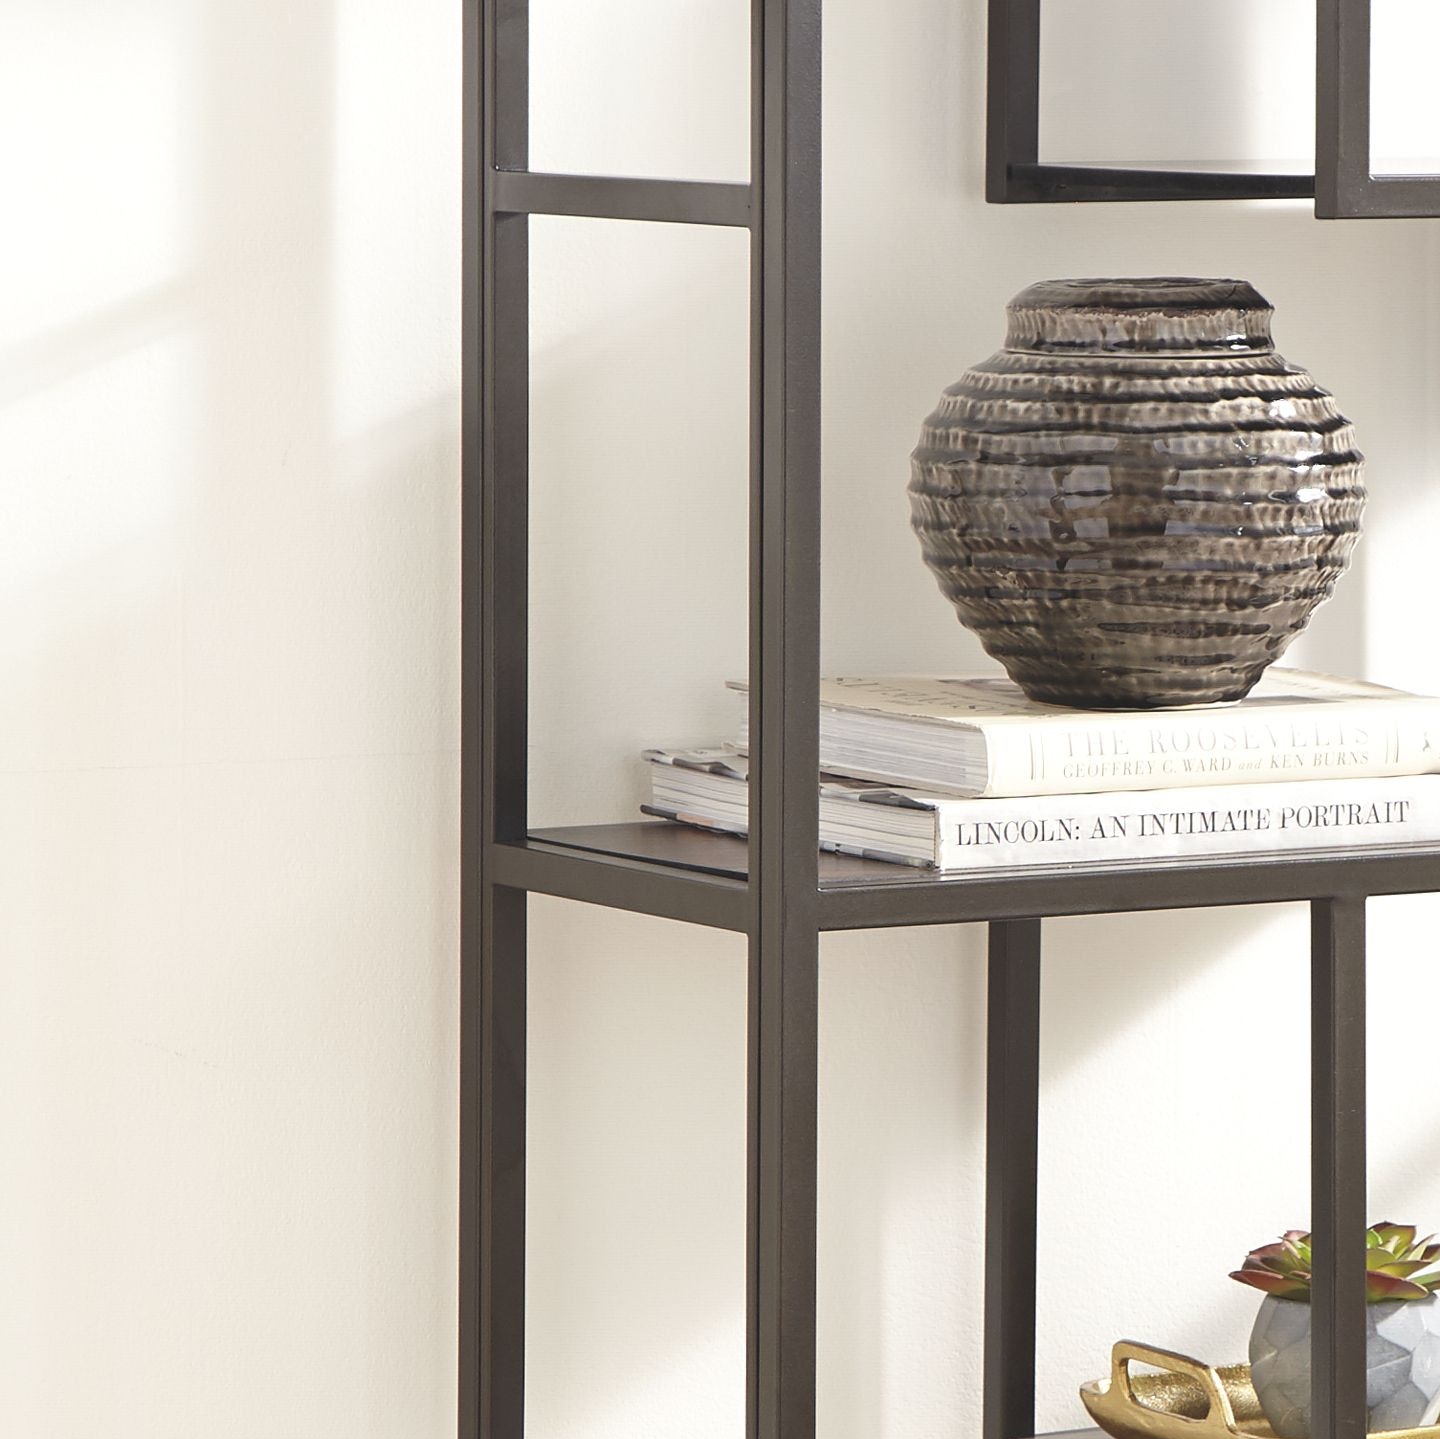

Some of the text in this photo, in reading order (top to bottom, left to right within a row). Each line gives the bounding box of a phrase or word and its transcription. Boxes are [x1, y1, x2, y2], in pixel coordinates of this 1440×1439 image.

[1061, 721, 1369, 757] THE ROOSEVELTS
[1063, 751, 1369, 779] GEOFFREY C. WARD and KEN BURNS
[955, 800, 1410, 846] LINCOLN: AN INTIMATE PORTRAIT
